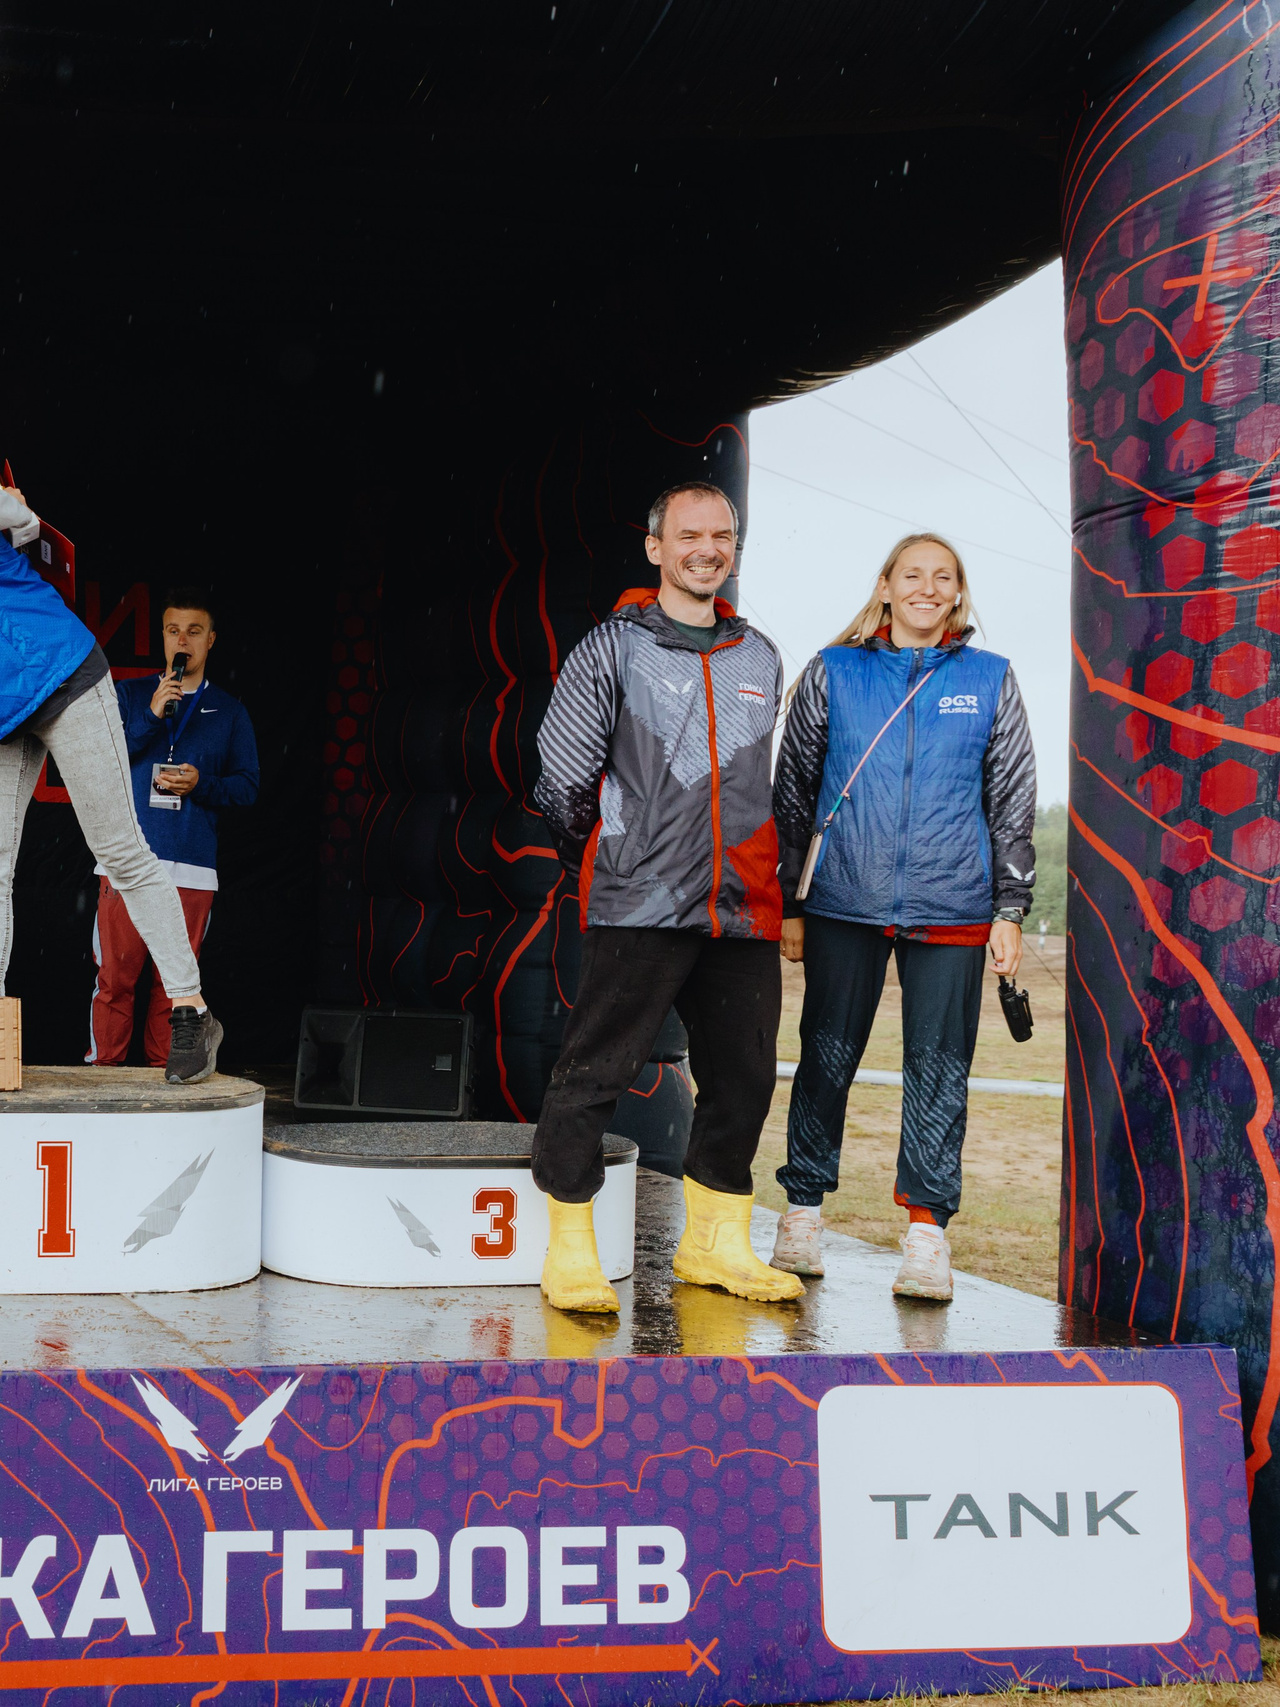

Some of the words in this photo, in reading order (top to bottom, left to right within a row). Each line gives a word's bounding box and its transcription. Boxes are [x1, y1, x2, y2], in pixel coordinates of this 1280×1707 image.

[738, 682, 764, 695] ГОНКА
[938, 707, 979, 715] RUSSIA
[36, 1141, 76, 1258] 1
[471, 1187, 518, 1260] 3
[147, 1477, 201, 1492] ЛИГА
[207, 1476, 283, 1491] ГЕРОЕВ
[869, 1490, 1141, 1540] TANK
[201, 1525, 692, 1633] ГЕРОЕВ
